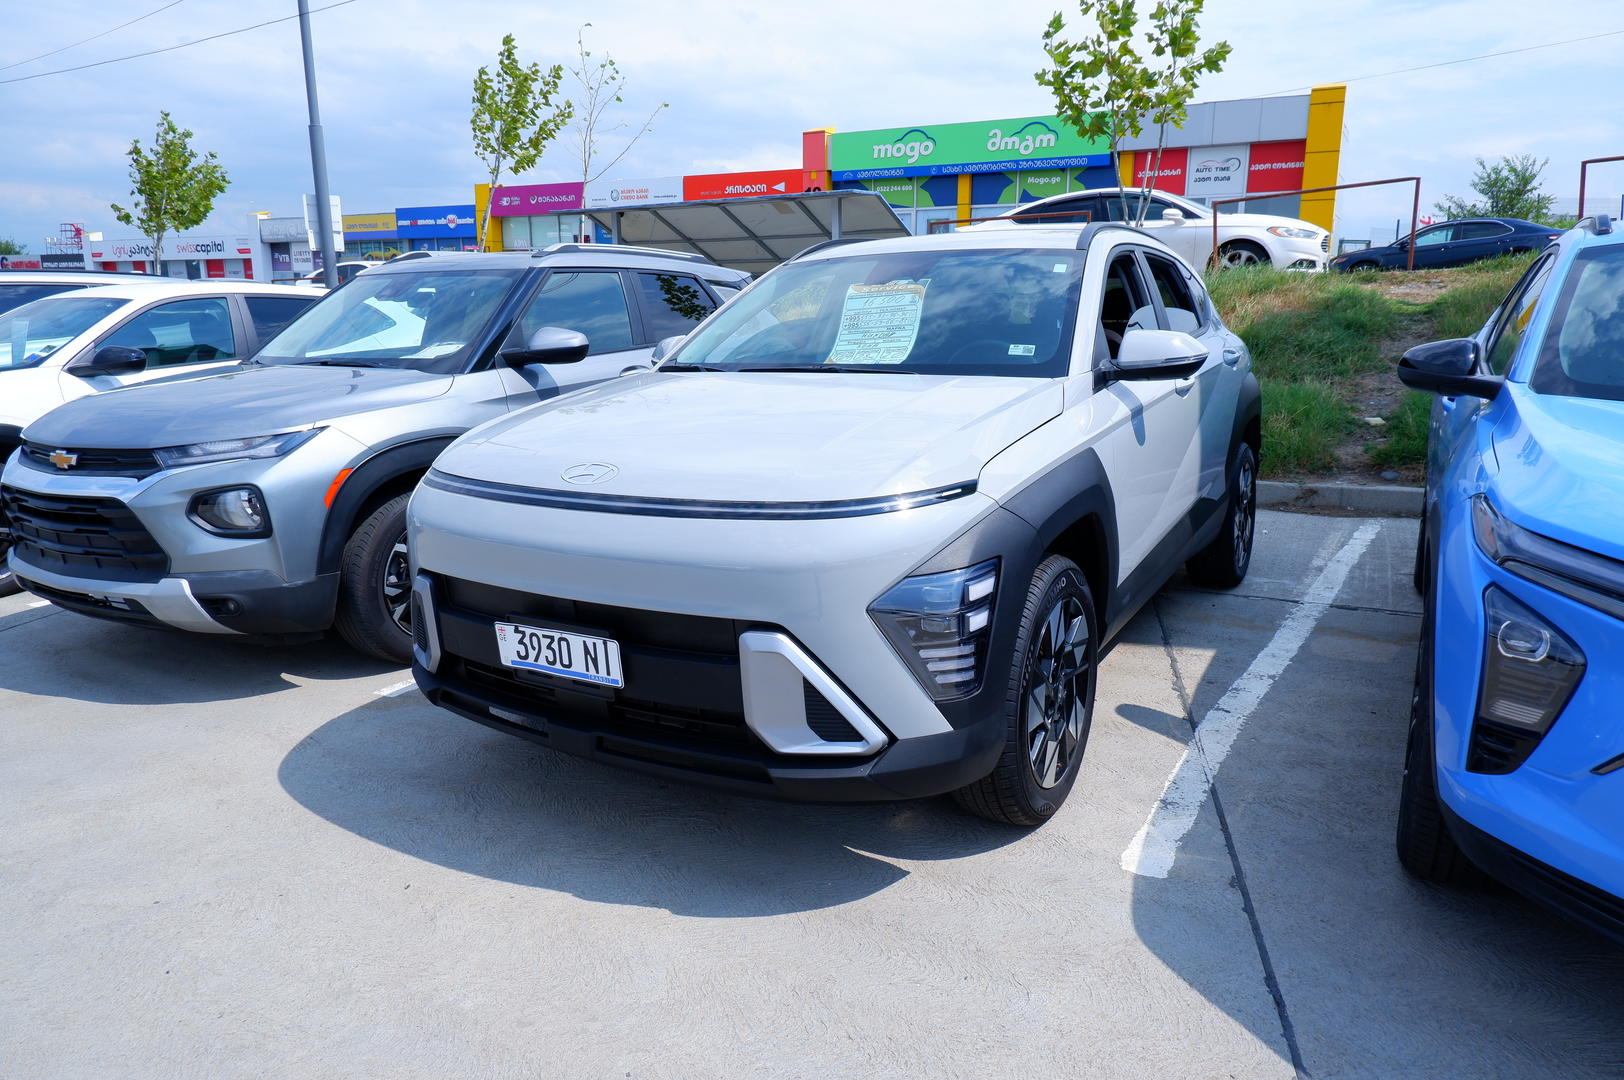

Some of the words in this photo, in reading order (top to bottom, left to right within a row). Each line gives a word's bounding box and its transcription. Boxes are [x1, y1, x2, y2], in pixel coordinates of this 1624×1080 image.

[987, 129, 1056, 155] მოგო
[873, 141, 934, 164] mogo
[1027, 176, 1061, 184] Mogo.ge
[176, 240, 225, 255] swisscapital
[278, 254, 290, 263] VTB
[514, 628, 573, 669] 3930
